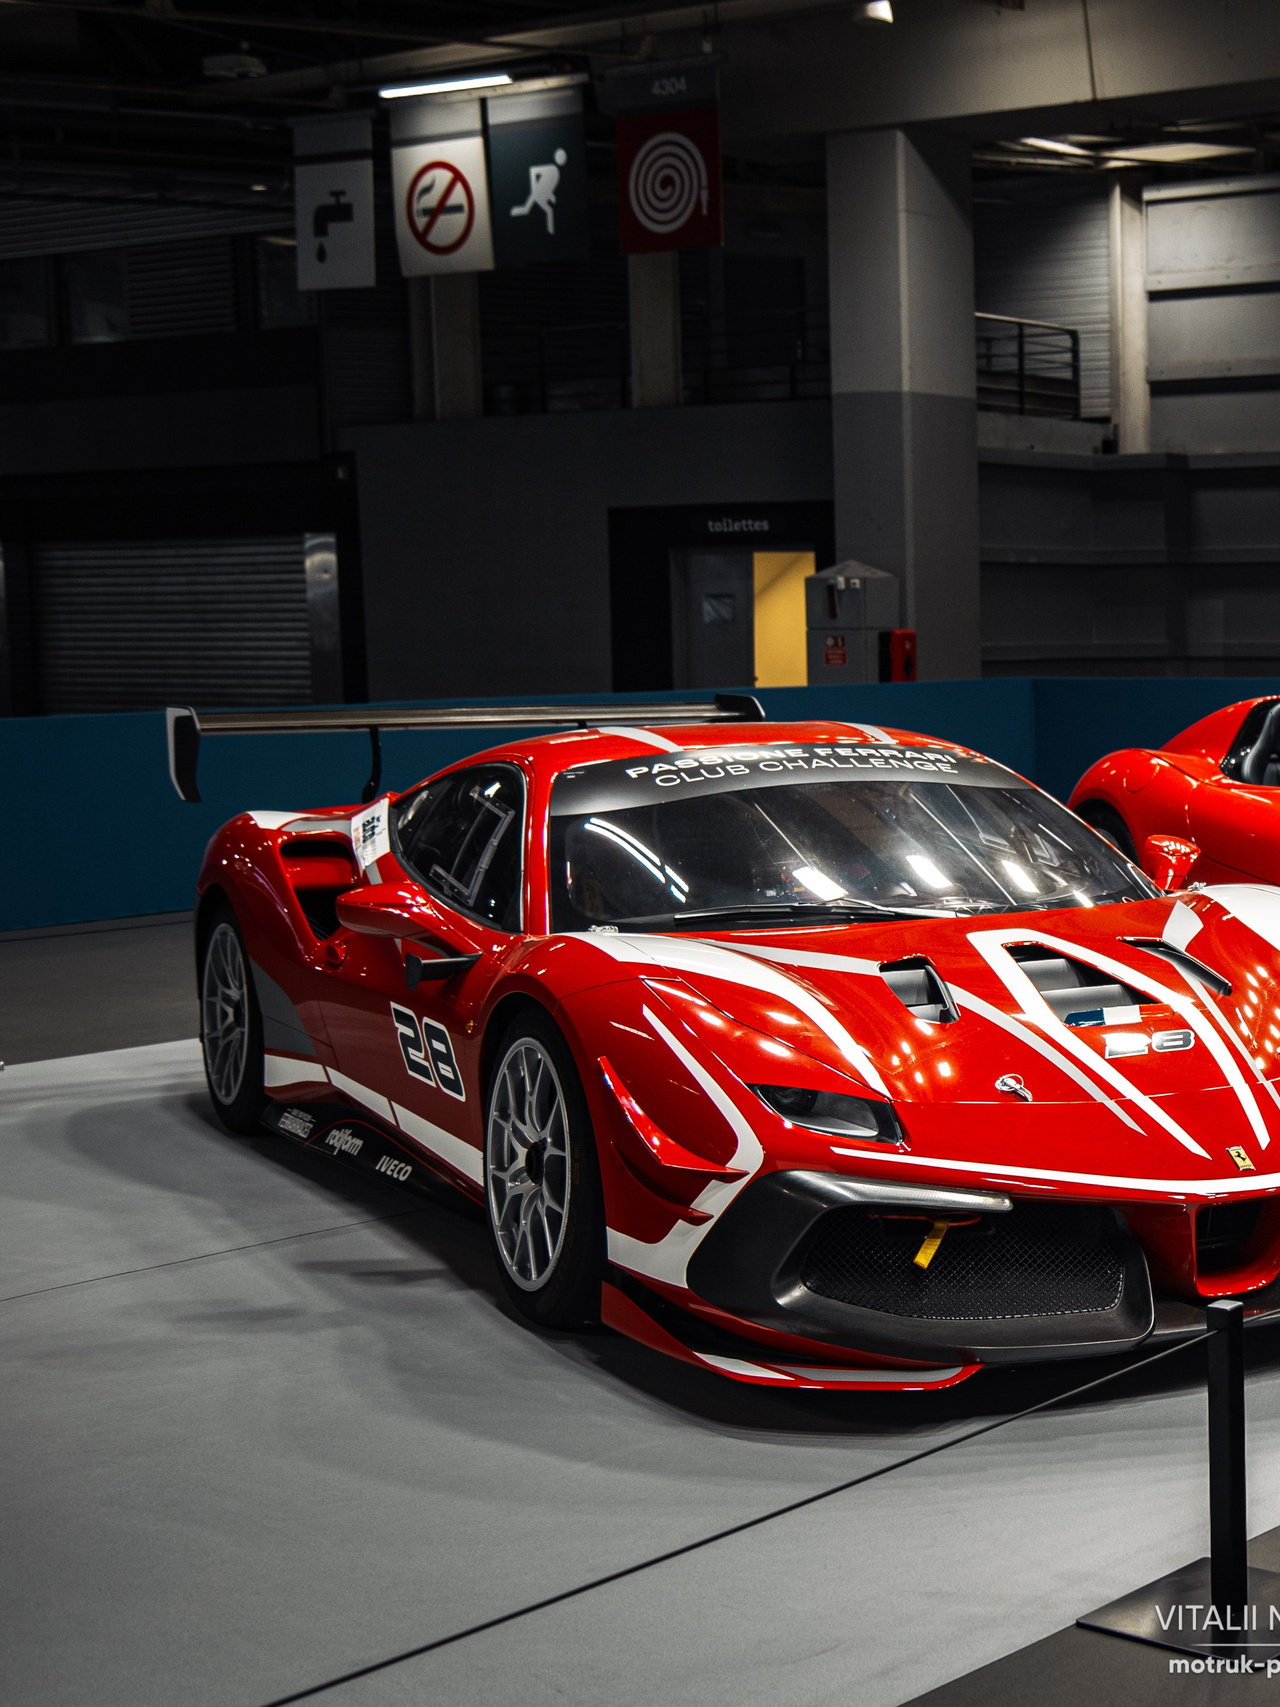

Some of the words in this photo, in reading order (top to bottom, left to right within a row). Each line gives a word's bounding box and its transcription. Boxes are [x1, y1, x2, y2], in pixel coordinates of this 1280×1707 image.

[651, 76, 687, 96] 4304
[707, 517, 770, 533] toilettes
[625, 747, 811, 779] PASSIONE
[813, 747, 957, 765] FERRARI
[655, 763, 751, 787] CLUB
[757, 757, 959, 774] CHALLENGE
[389, 1001, 466, 1102] 28
[375, 1155, 413, 1182] IVECO
